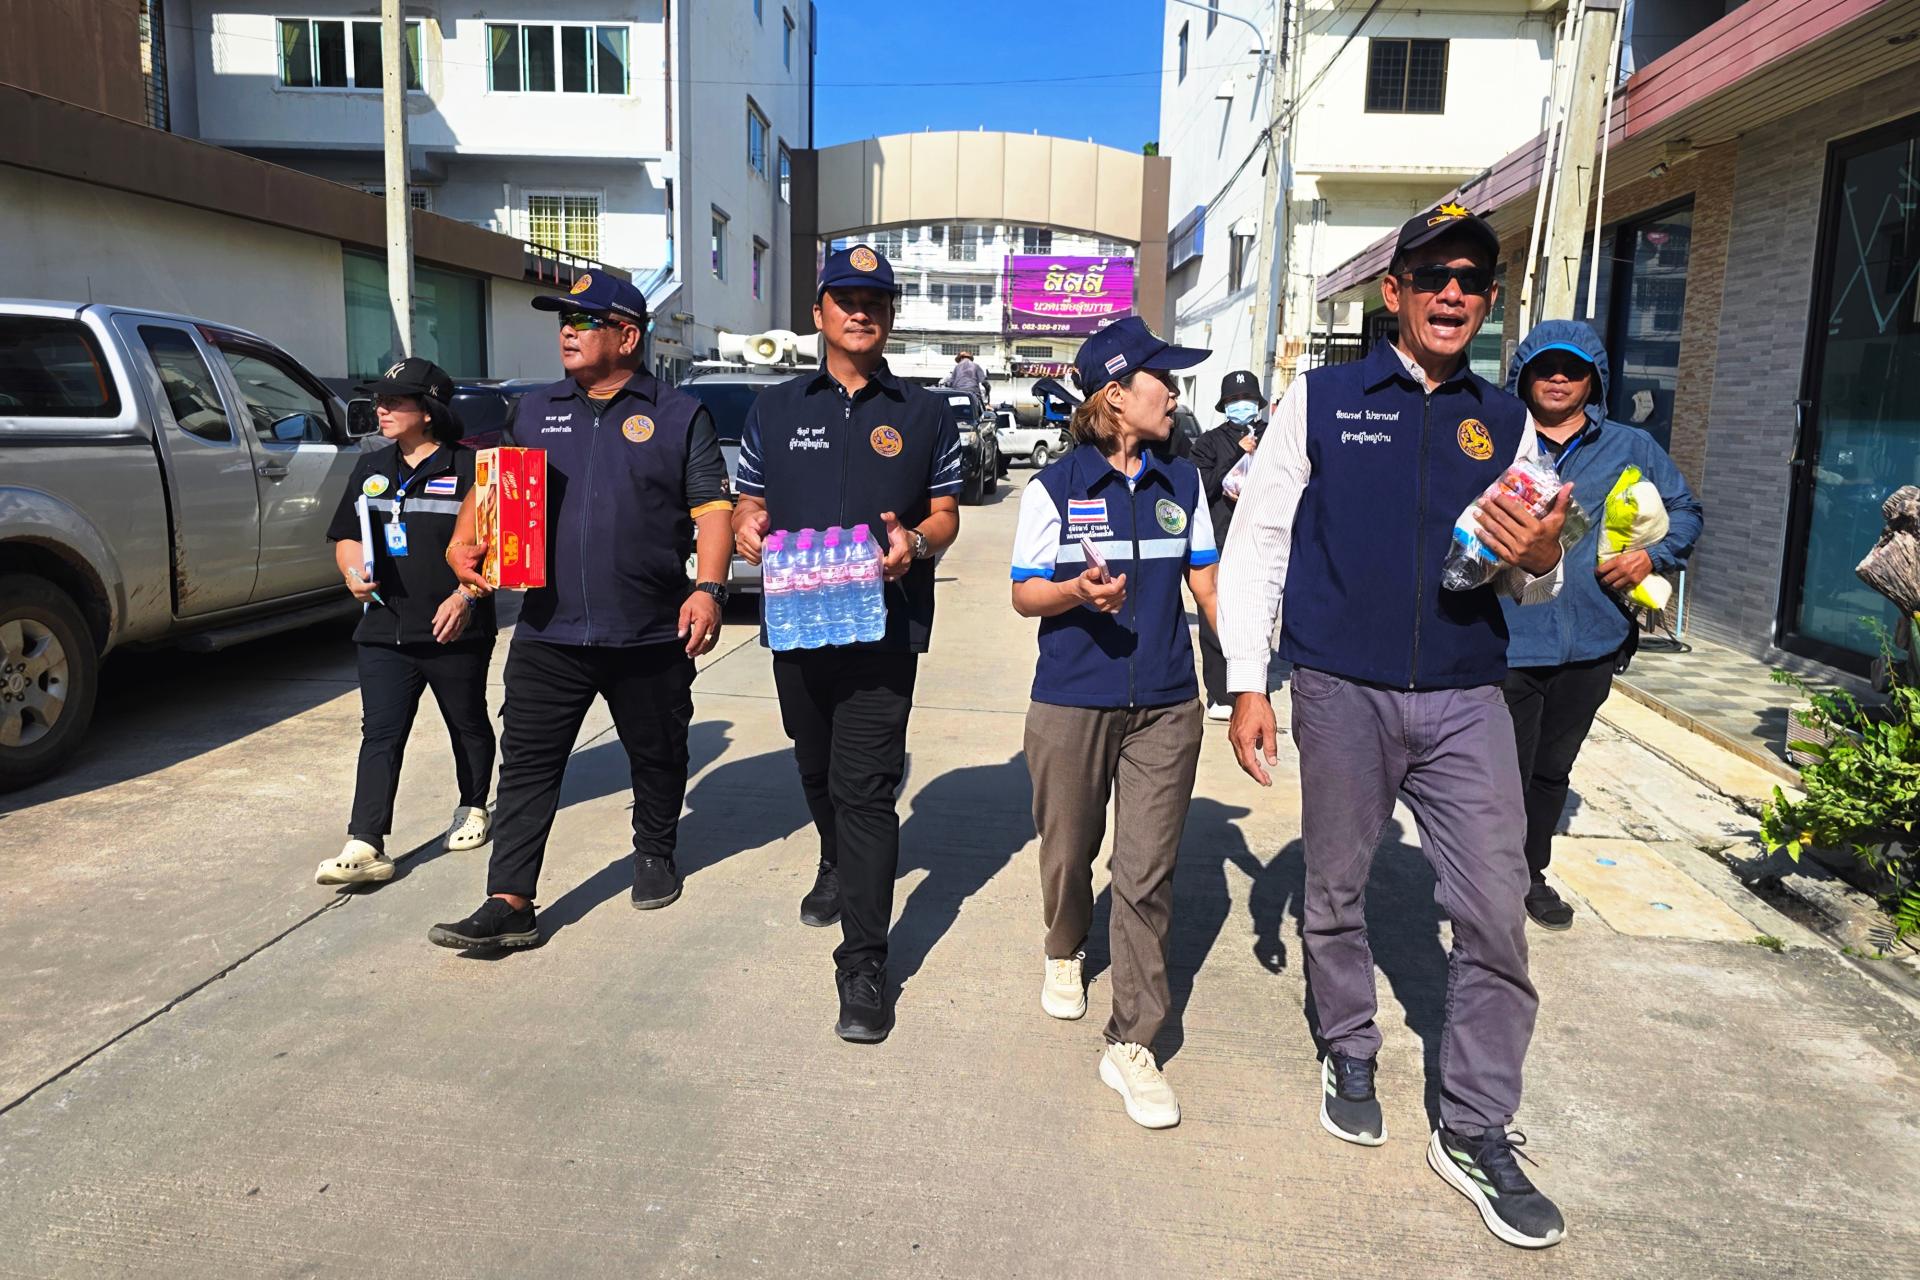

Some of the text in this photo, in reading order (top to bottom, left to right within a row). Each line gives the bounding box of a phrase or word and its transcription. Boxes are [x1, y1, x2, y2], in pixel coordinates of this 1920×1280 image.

[1043, 258, 1109, 293] ลิลลี่
[1033, 297, 1113, 316] นวดเพื่อสุขภาพ
[789, 438, 830, 450] ผู้ช่วยผู้ใหญ่บ้าน
[1340, 431, 1392, 444] ผู้ช่วยผู้ใหญ่บ้าน
